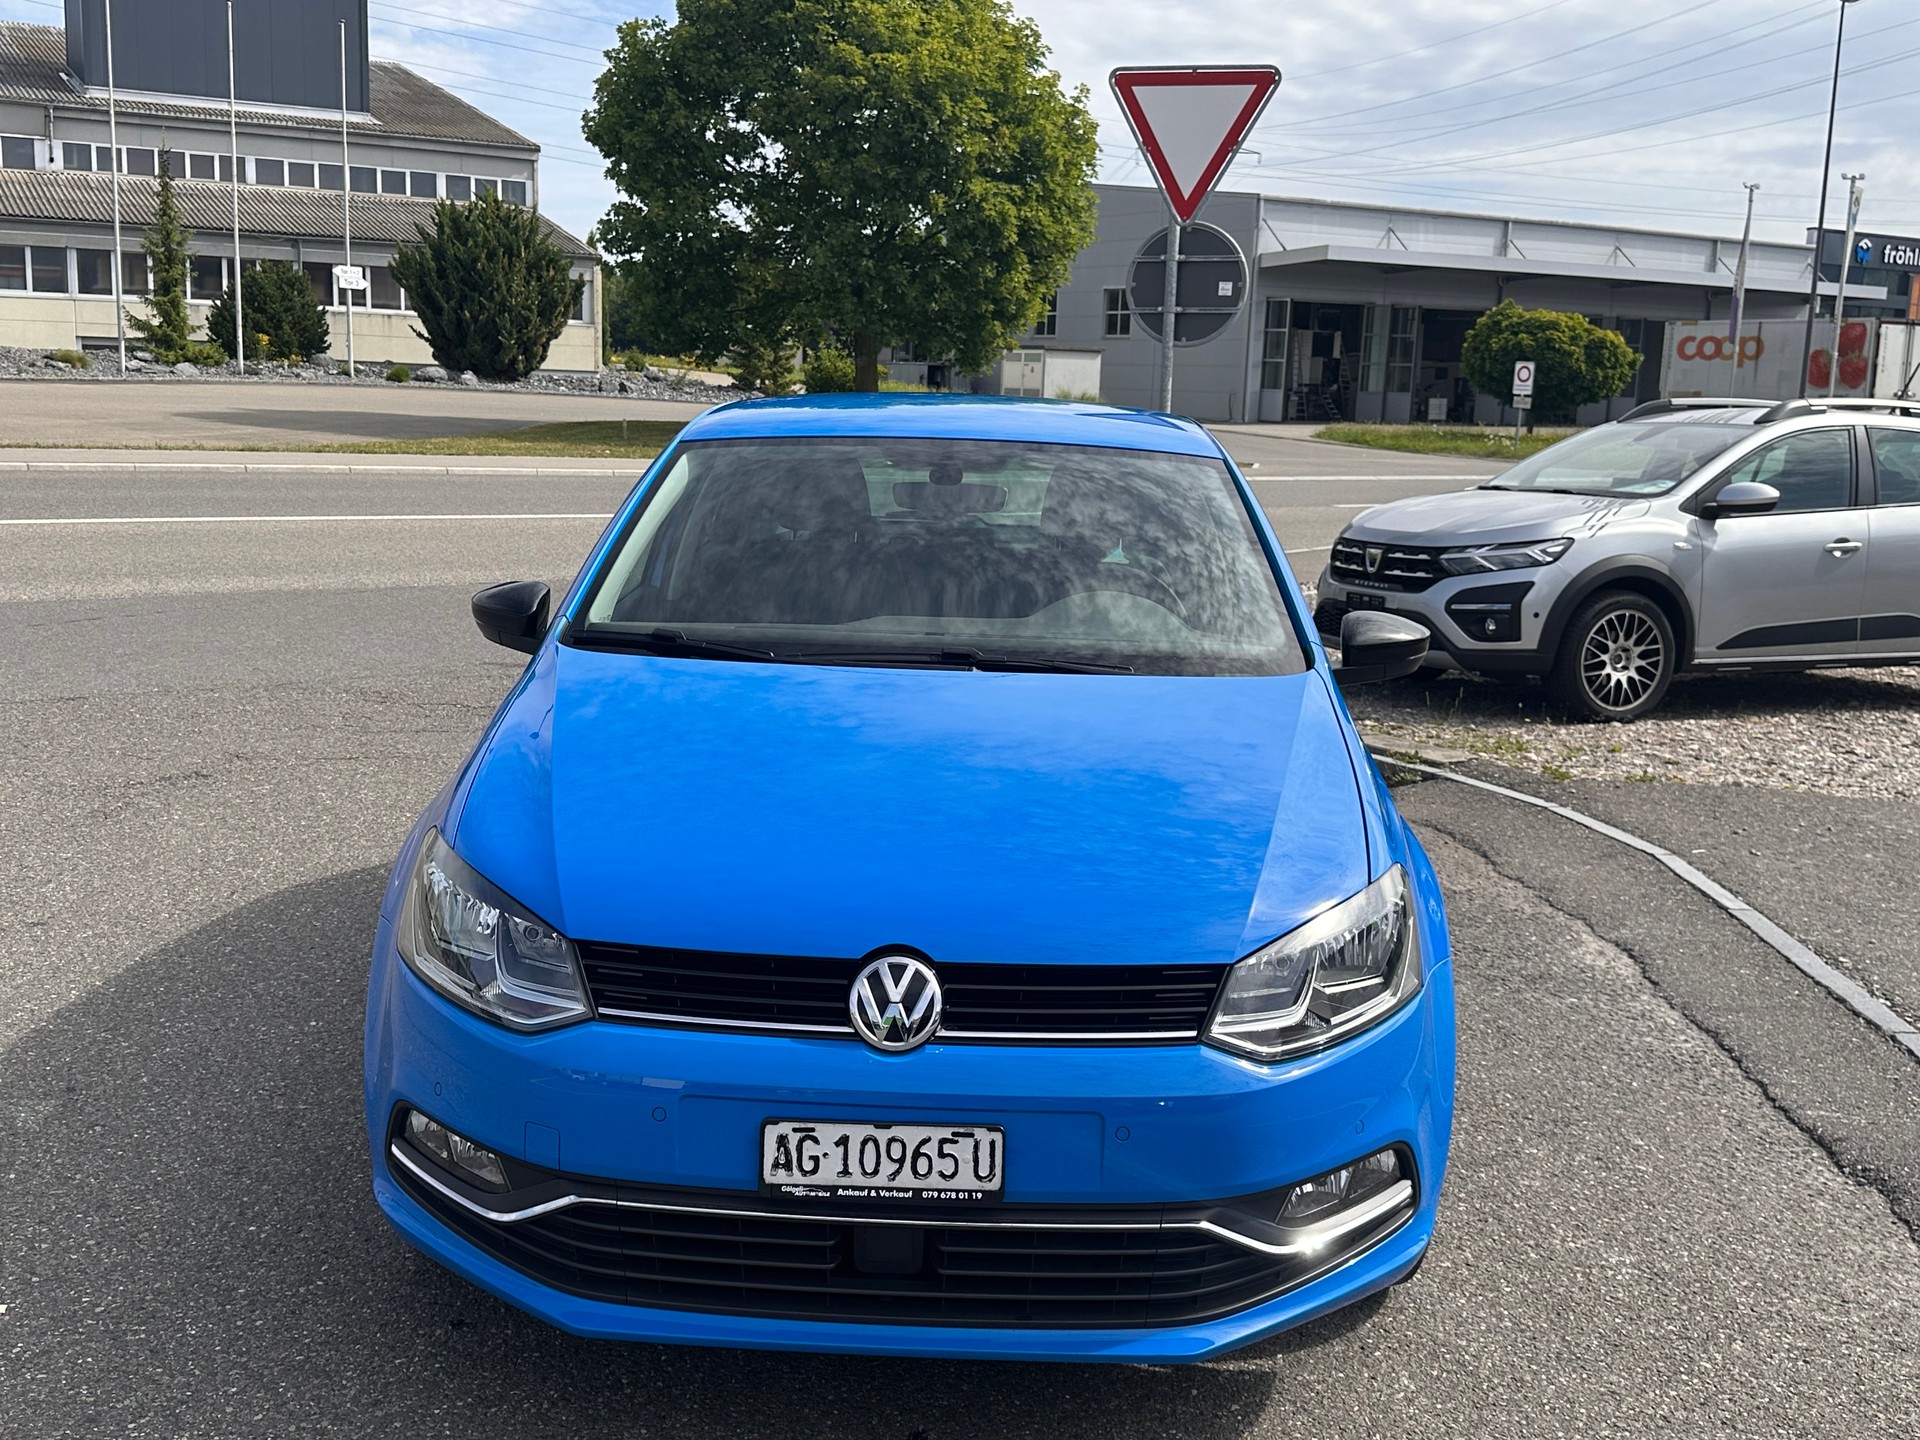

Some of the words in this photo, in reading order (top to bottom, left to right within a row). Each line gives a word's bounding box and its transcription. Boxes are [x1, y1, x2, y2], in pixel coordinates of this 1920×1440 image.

[1884, 244, 1920, 266] fröhl
[344, 278, 354, 286] Tor
[1676, 335, 1765, 368] coop
[1355, 580, 1388, 588] STEPWAY
[836, 1188, 868, 1197] Ankauf
[869, 1189, 877, 1197] &
[879, 1189, 913, 1198] Verkauf
[922, 1190, 938, 1199] 079
[940, 1191, 957, 1199] 678
[958, 1191, 969, 1200] 01
[971, 1191, 983, 1200] 19
